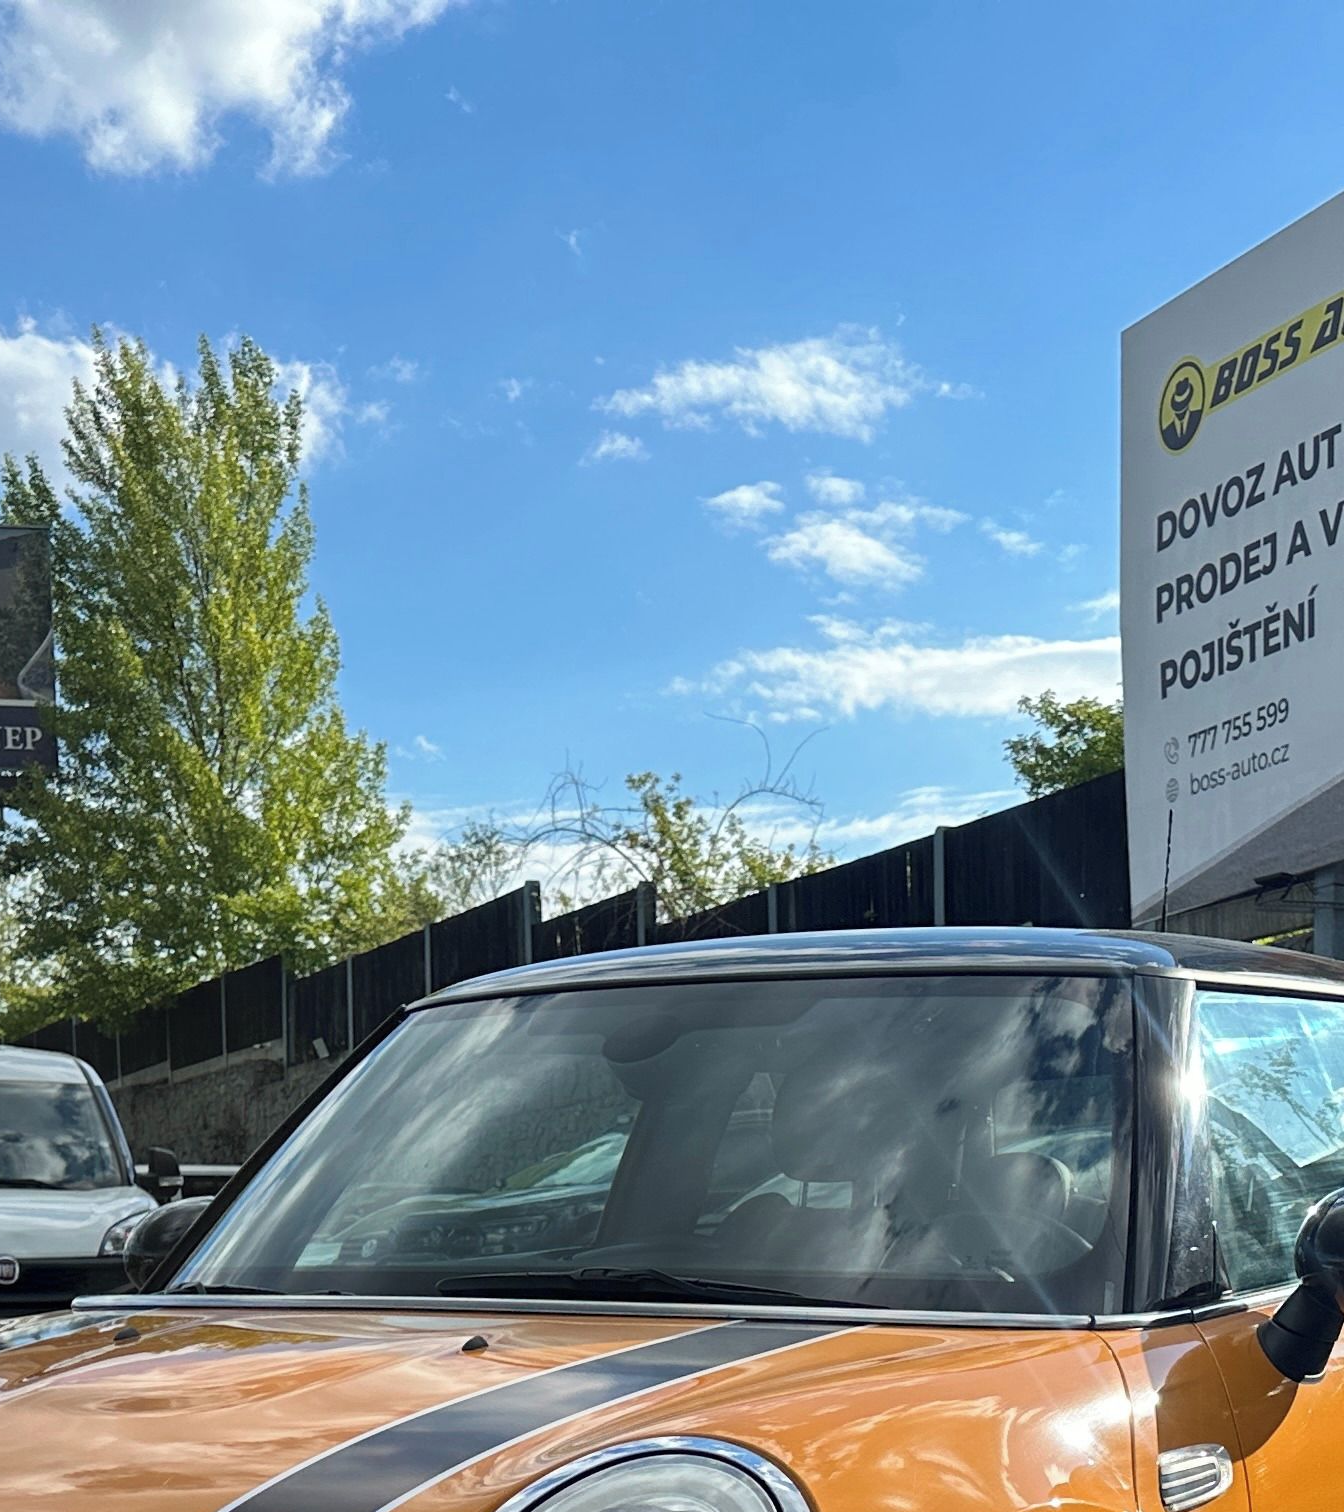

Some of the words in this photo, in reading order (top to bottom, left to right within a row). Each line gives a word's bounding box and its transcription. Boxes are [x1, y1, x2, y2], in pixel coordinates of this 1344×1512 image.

[1210, 318, 1304, 408] BOSS
[1156, 461, 1266, 553] DOVOZ
[1272, 422, 1342, 496] AUT
[1156, 531, 1278, 624] PRODEJ
[1285, 519, 1312, 566] A
[1160, 584, 1320, 700] POJIŠTĚNÍ
[1187, 724, 1218, 758] 777
[1222, 710, 1252, 745] 755
[1256, 697, 1289, 732] 599
[1190, 743, 1290, 796] boss-auto.cz
